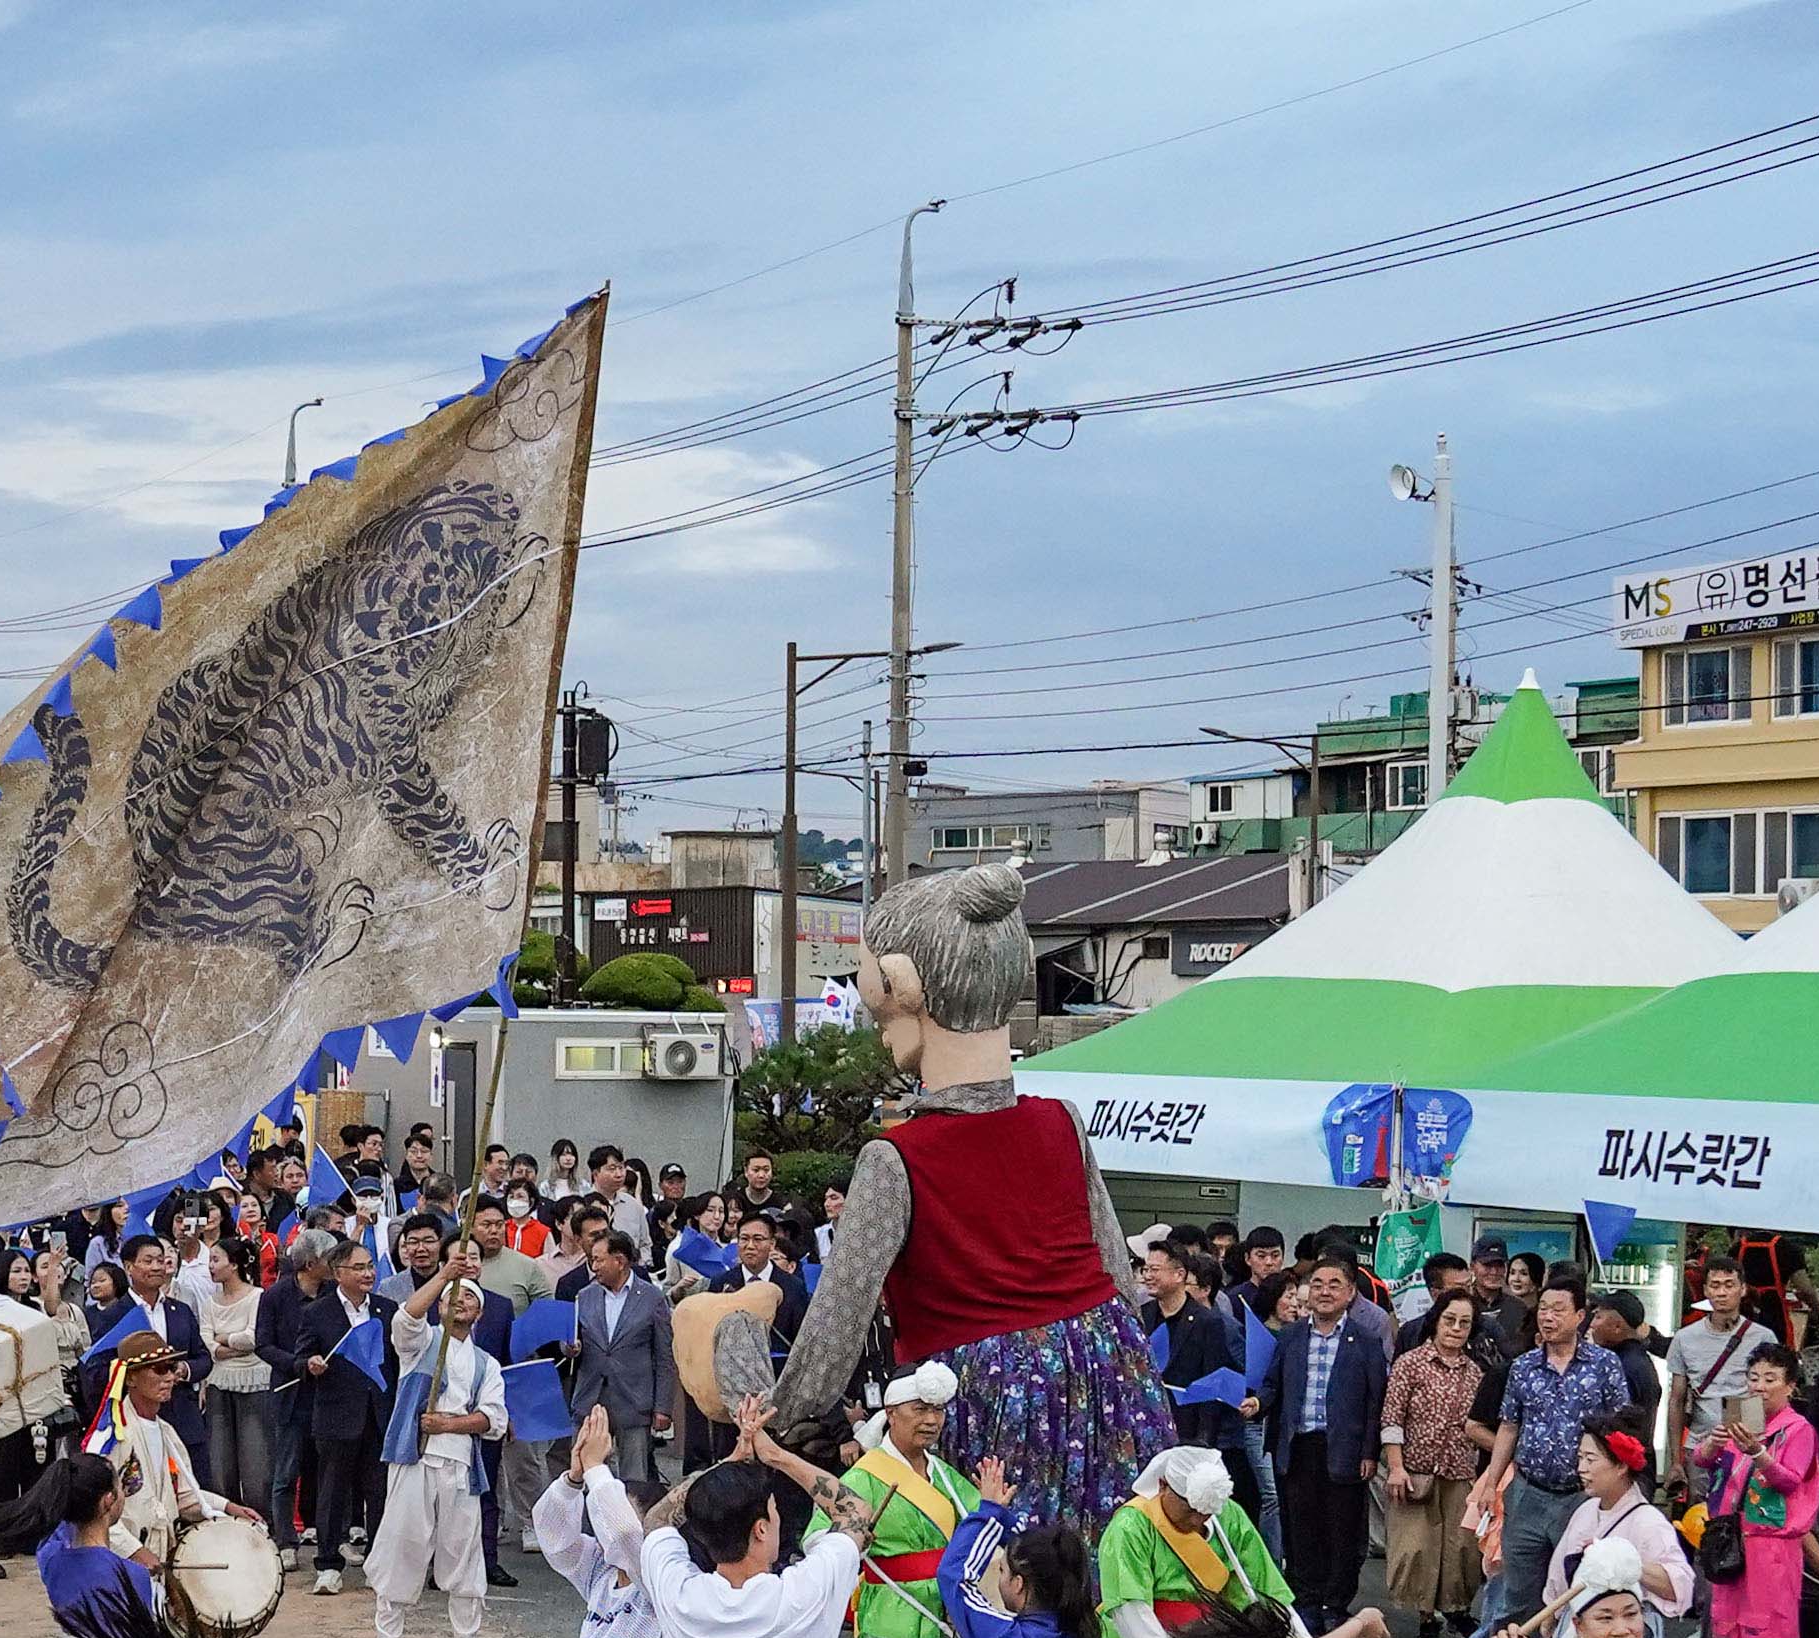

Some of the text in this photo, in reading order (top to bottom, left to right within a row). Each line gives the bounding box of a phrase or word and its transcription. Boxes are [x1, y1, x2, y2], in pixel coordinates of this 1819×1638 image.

[1624, 577, 1672, 620] MS
[1189, 943, 1237, 962] ROCKET
[1087, 1099, 1207, 1145] 파시수랏간
[1598, 1129, 1771, 1190] 파시수랏간
